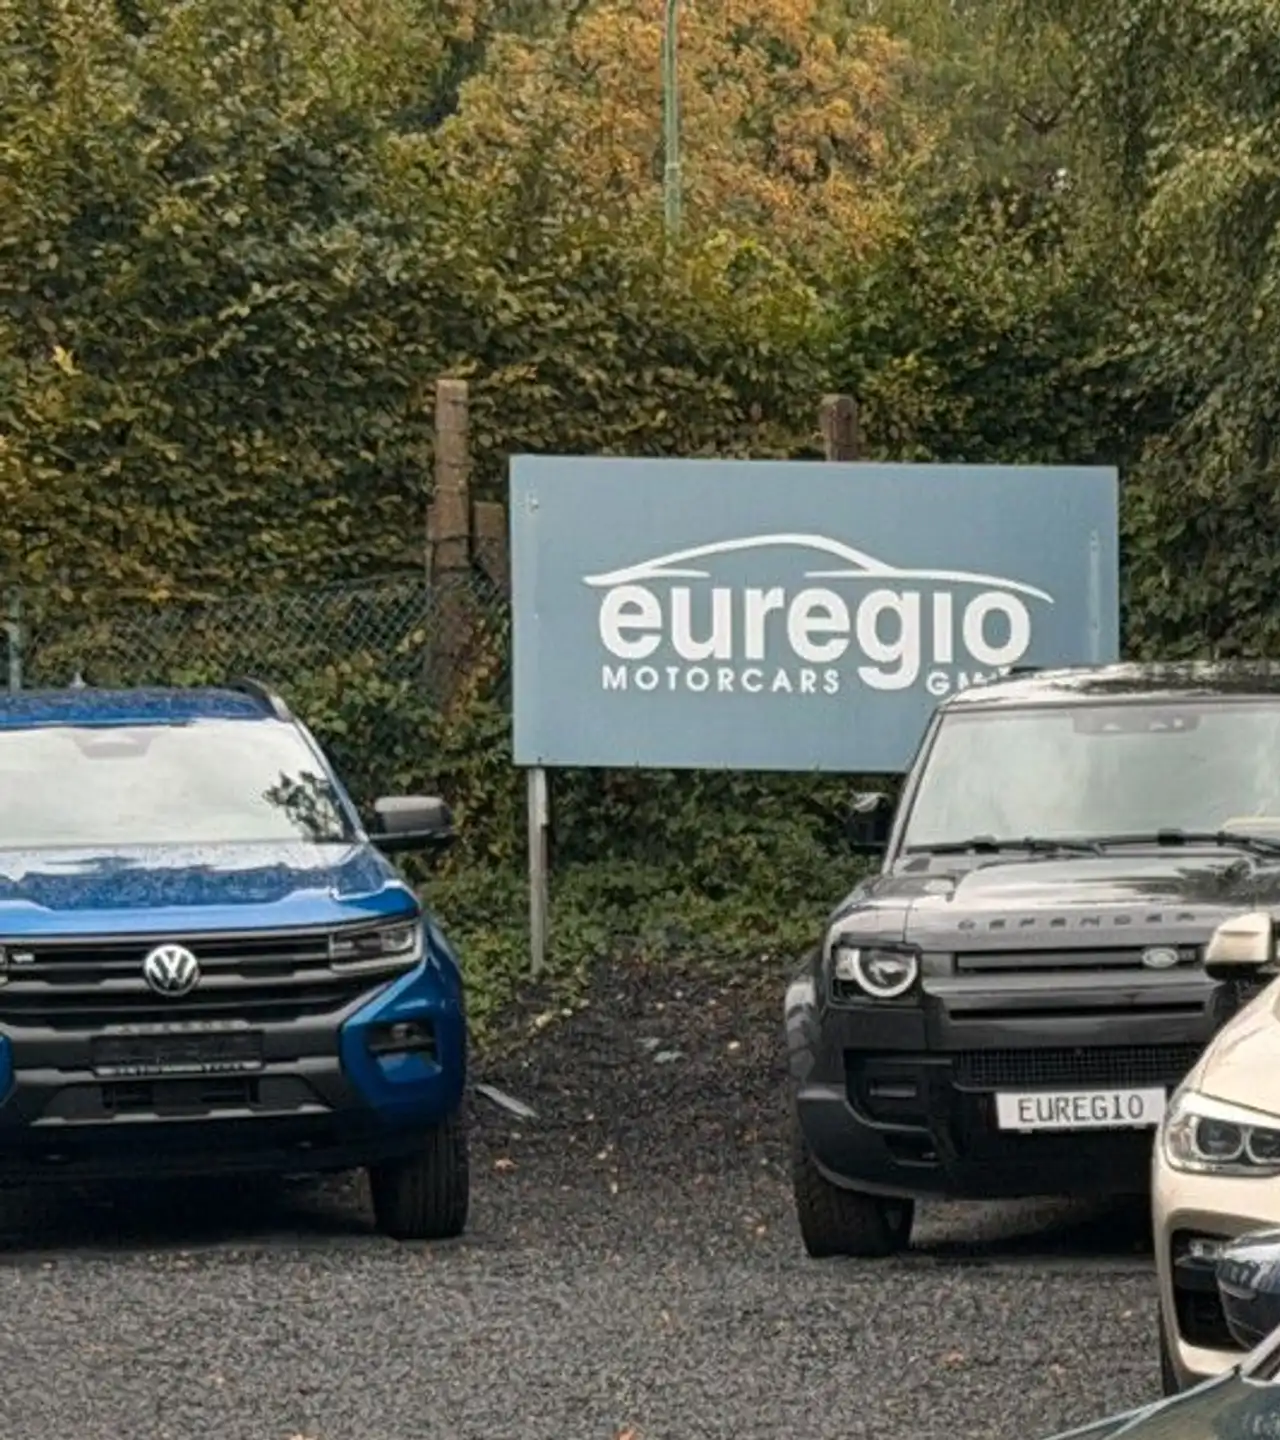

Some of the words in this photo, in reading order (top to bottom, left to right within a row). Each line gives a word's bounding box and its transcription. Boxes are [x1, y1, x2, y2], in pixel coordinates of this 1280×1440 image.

[599, 584, 1030, 690] euregio
[602, 664, 840, 694] MOTORCARS
[1017, 1094, 1145, 1123] EUREGIO
